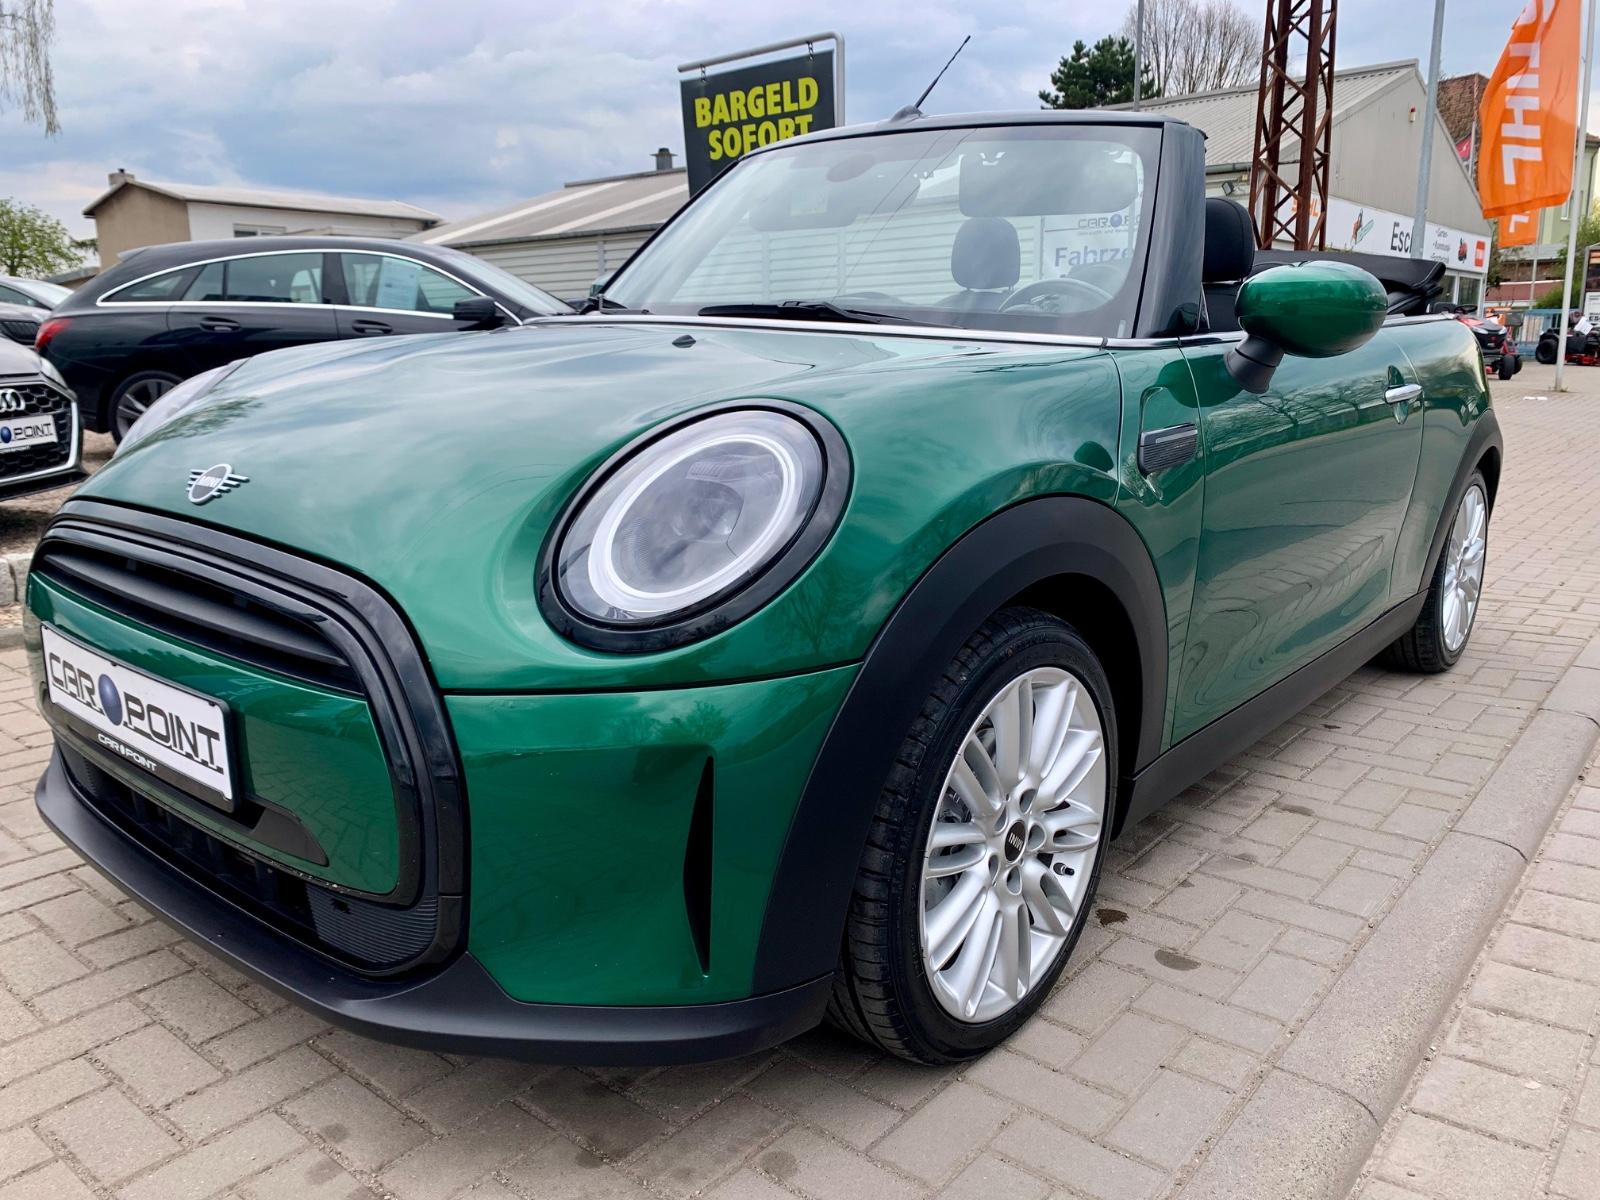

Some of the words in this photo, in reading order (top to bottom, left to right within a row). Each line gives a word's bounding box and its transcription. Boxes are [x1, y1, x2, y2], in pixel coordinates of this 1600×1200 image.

[694, 77, 819, 128] BARGELD
[708, 114, 813, 160] SOFORT
[1390, 221, 1413, 253] Esc
[13, 423, 52, 440] POINT
[48, 652, 104, 712] CAR
[124, 695, 224, 775] POINT
[97, 733, 120, 752] CAR
[125, 747, 158, 772] POINT
